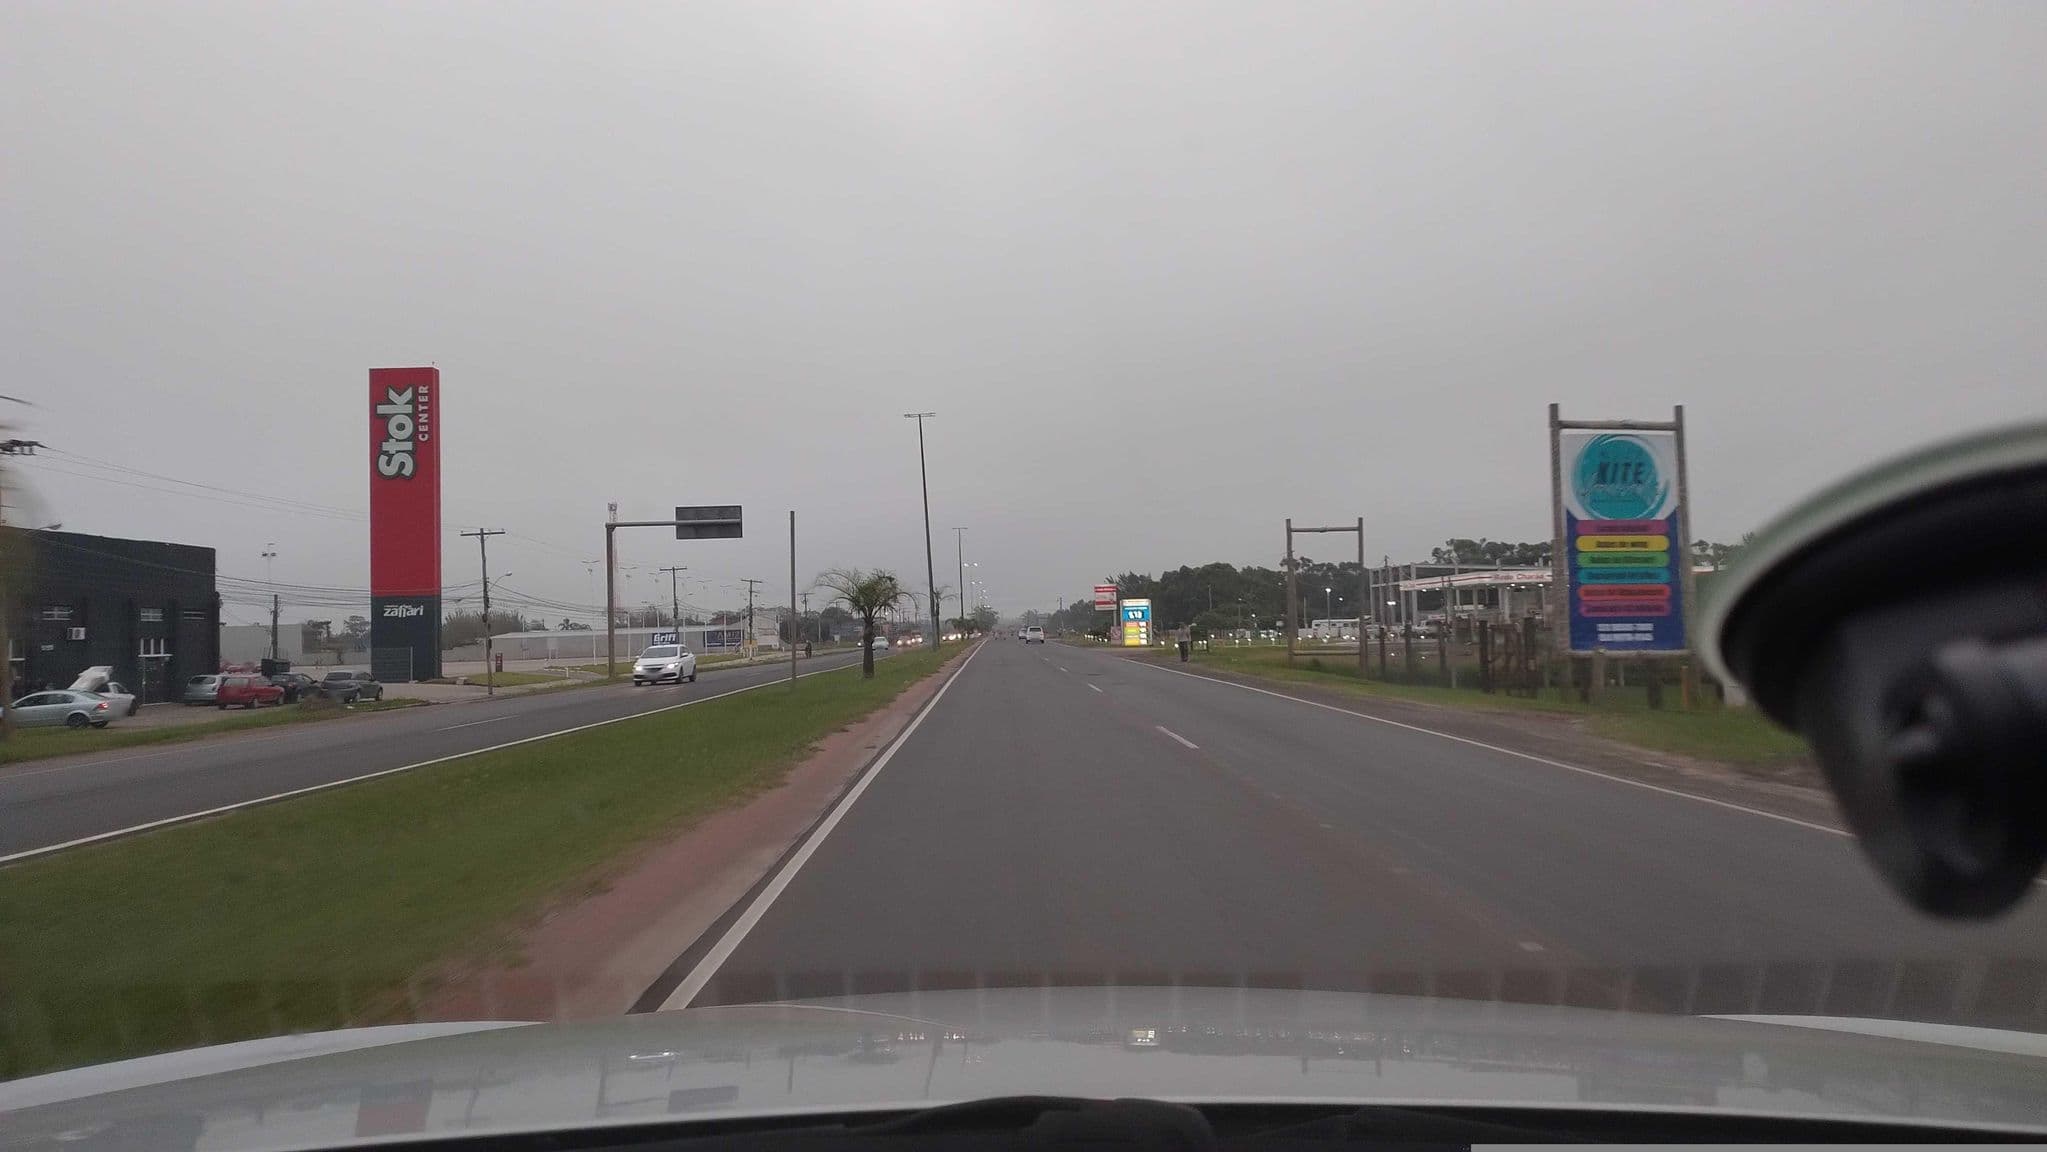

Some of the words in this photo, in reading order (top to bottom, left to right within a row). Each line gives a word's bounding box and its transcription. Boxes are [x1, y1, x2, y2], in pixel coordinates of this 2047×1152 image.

[376, 386, 414, 477] Stok
[418, 384, 429, 442] CENTER
[383, 605, 424, 618] zaffari
